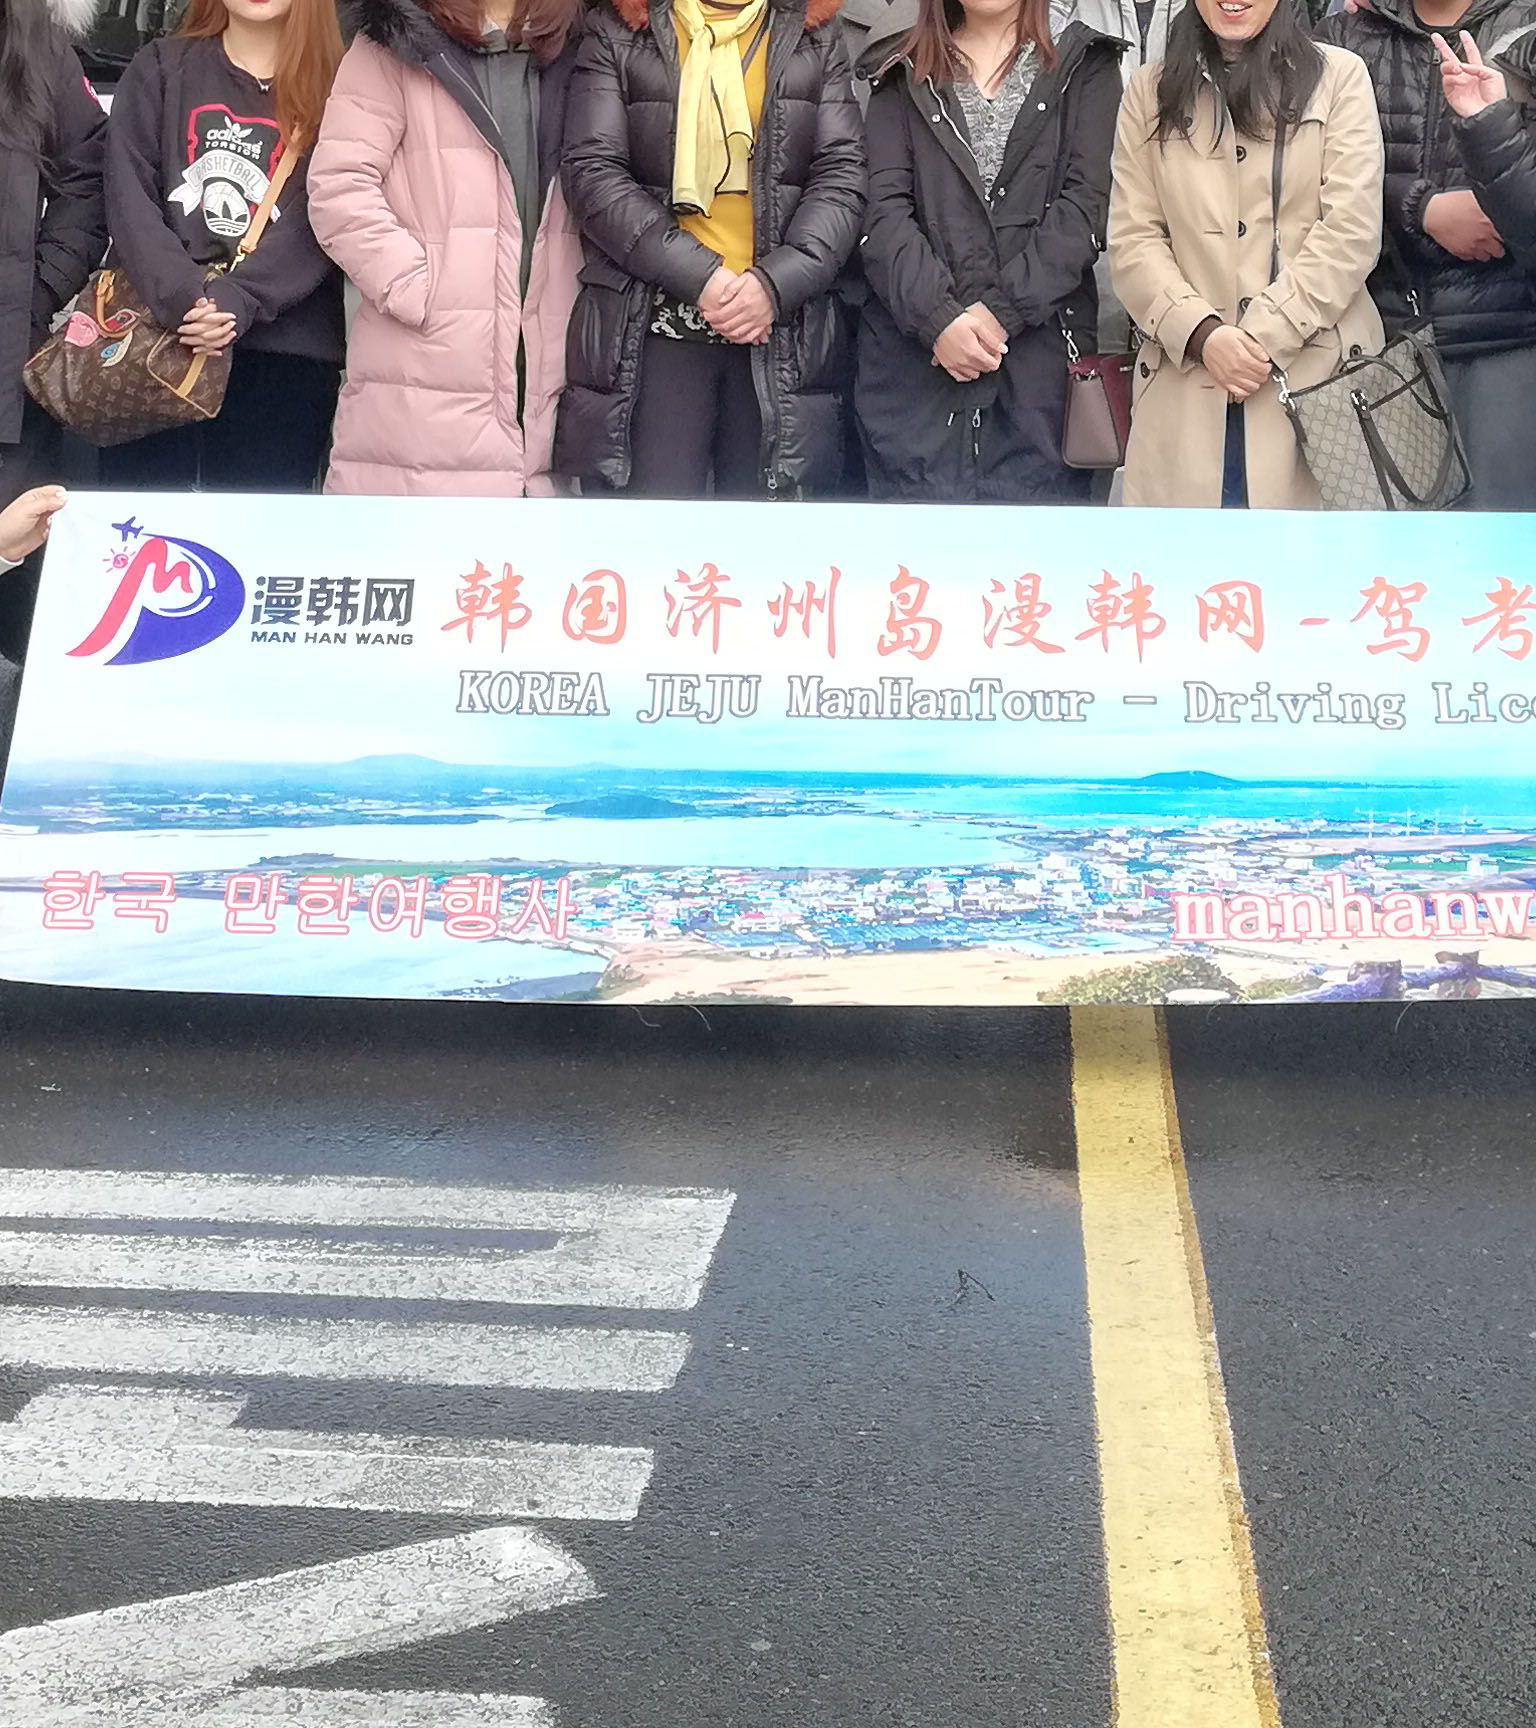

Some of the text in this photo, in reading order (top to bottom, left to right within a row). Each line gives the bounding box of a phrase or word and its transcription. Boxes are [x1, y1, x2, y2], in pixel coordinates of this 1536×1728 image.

[250, 575, 415, 627] 漫韩网
[251, 631, 414, 646] MAN HAN WANG
[456, 670, 610, 717] KOREA
[636, 673, 762, 724] JEJU
[786, 675, 1095, 723] ManHanTour
[1184, 681, 1406, 730] Driving
[43, 870, 578, 940] 한국 만한여행사
